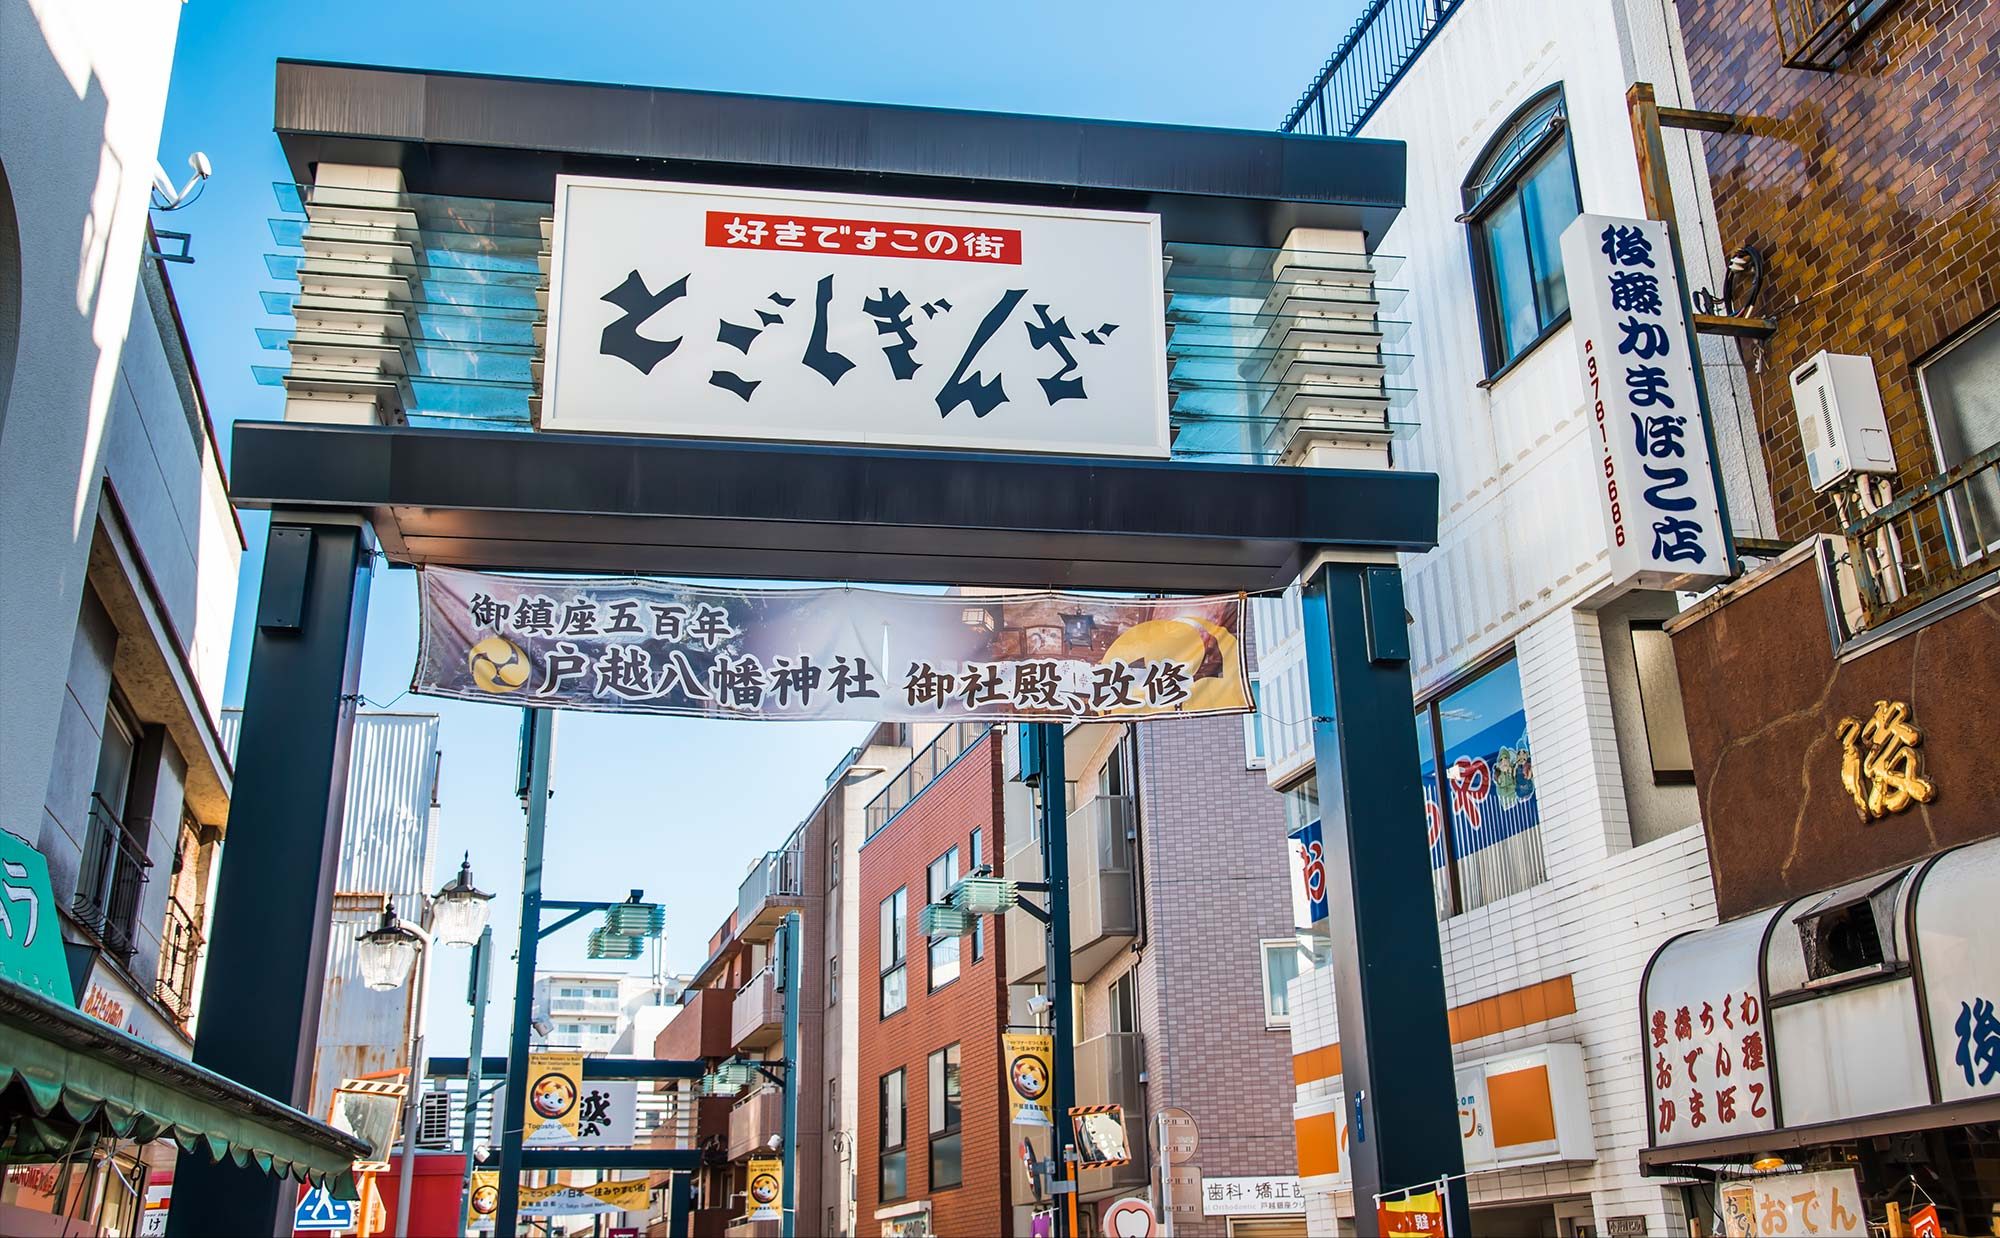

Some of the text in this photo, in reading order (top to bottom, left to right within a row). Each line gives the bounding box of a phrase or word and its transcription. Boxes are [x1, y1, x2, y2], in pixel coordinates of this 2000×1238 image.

[723, 215, 1006, 260] 好きですこの街
[599, 268, 1121, 419] とごしぎんざ
[1601, 223, 1708, 565] 後藤かまぼこ店
[470, 591, 732, 647] 御鎮座五百年
[539, 641, 880, 709] 戸越八幡神社
[0, 858, 39, 948] ラ
[1656, 1031, 1765, 1090] おでん種
[1457, 1095, 1475, 1106] om
[1659, 1083, 1767, 1134] かまぼこ
[1759, 1187, 1858, 1236] おでん
